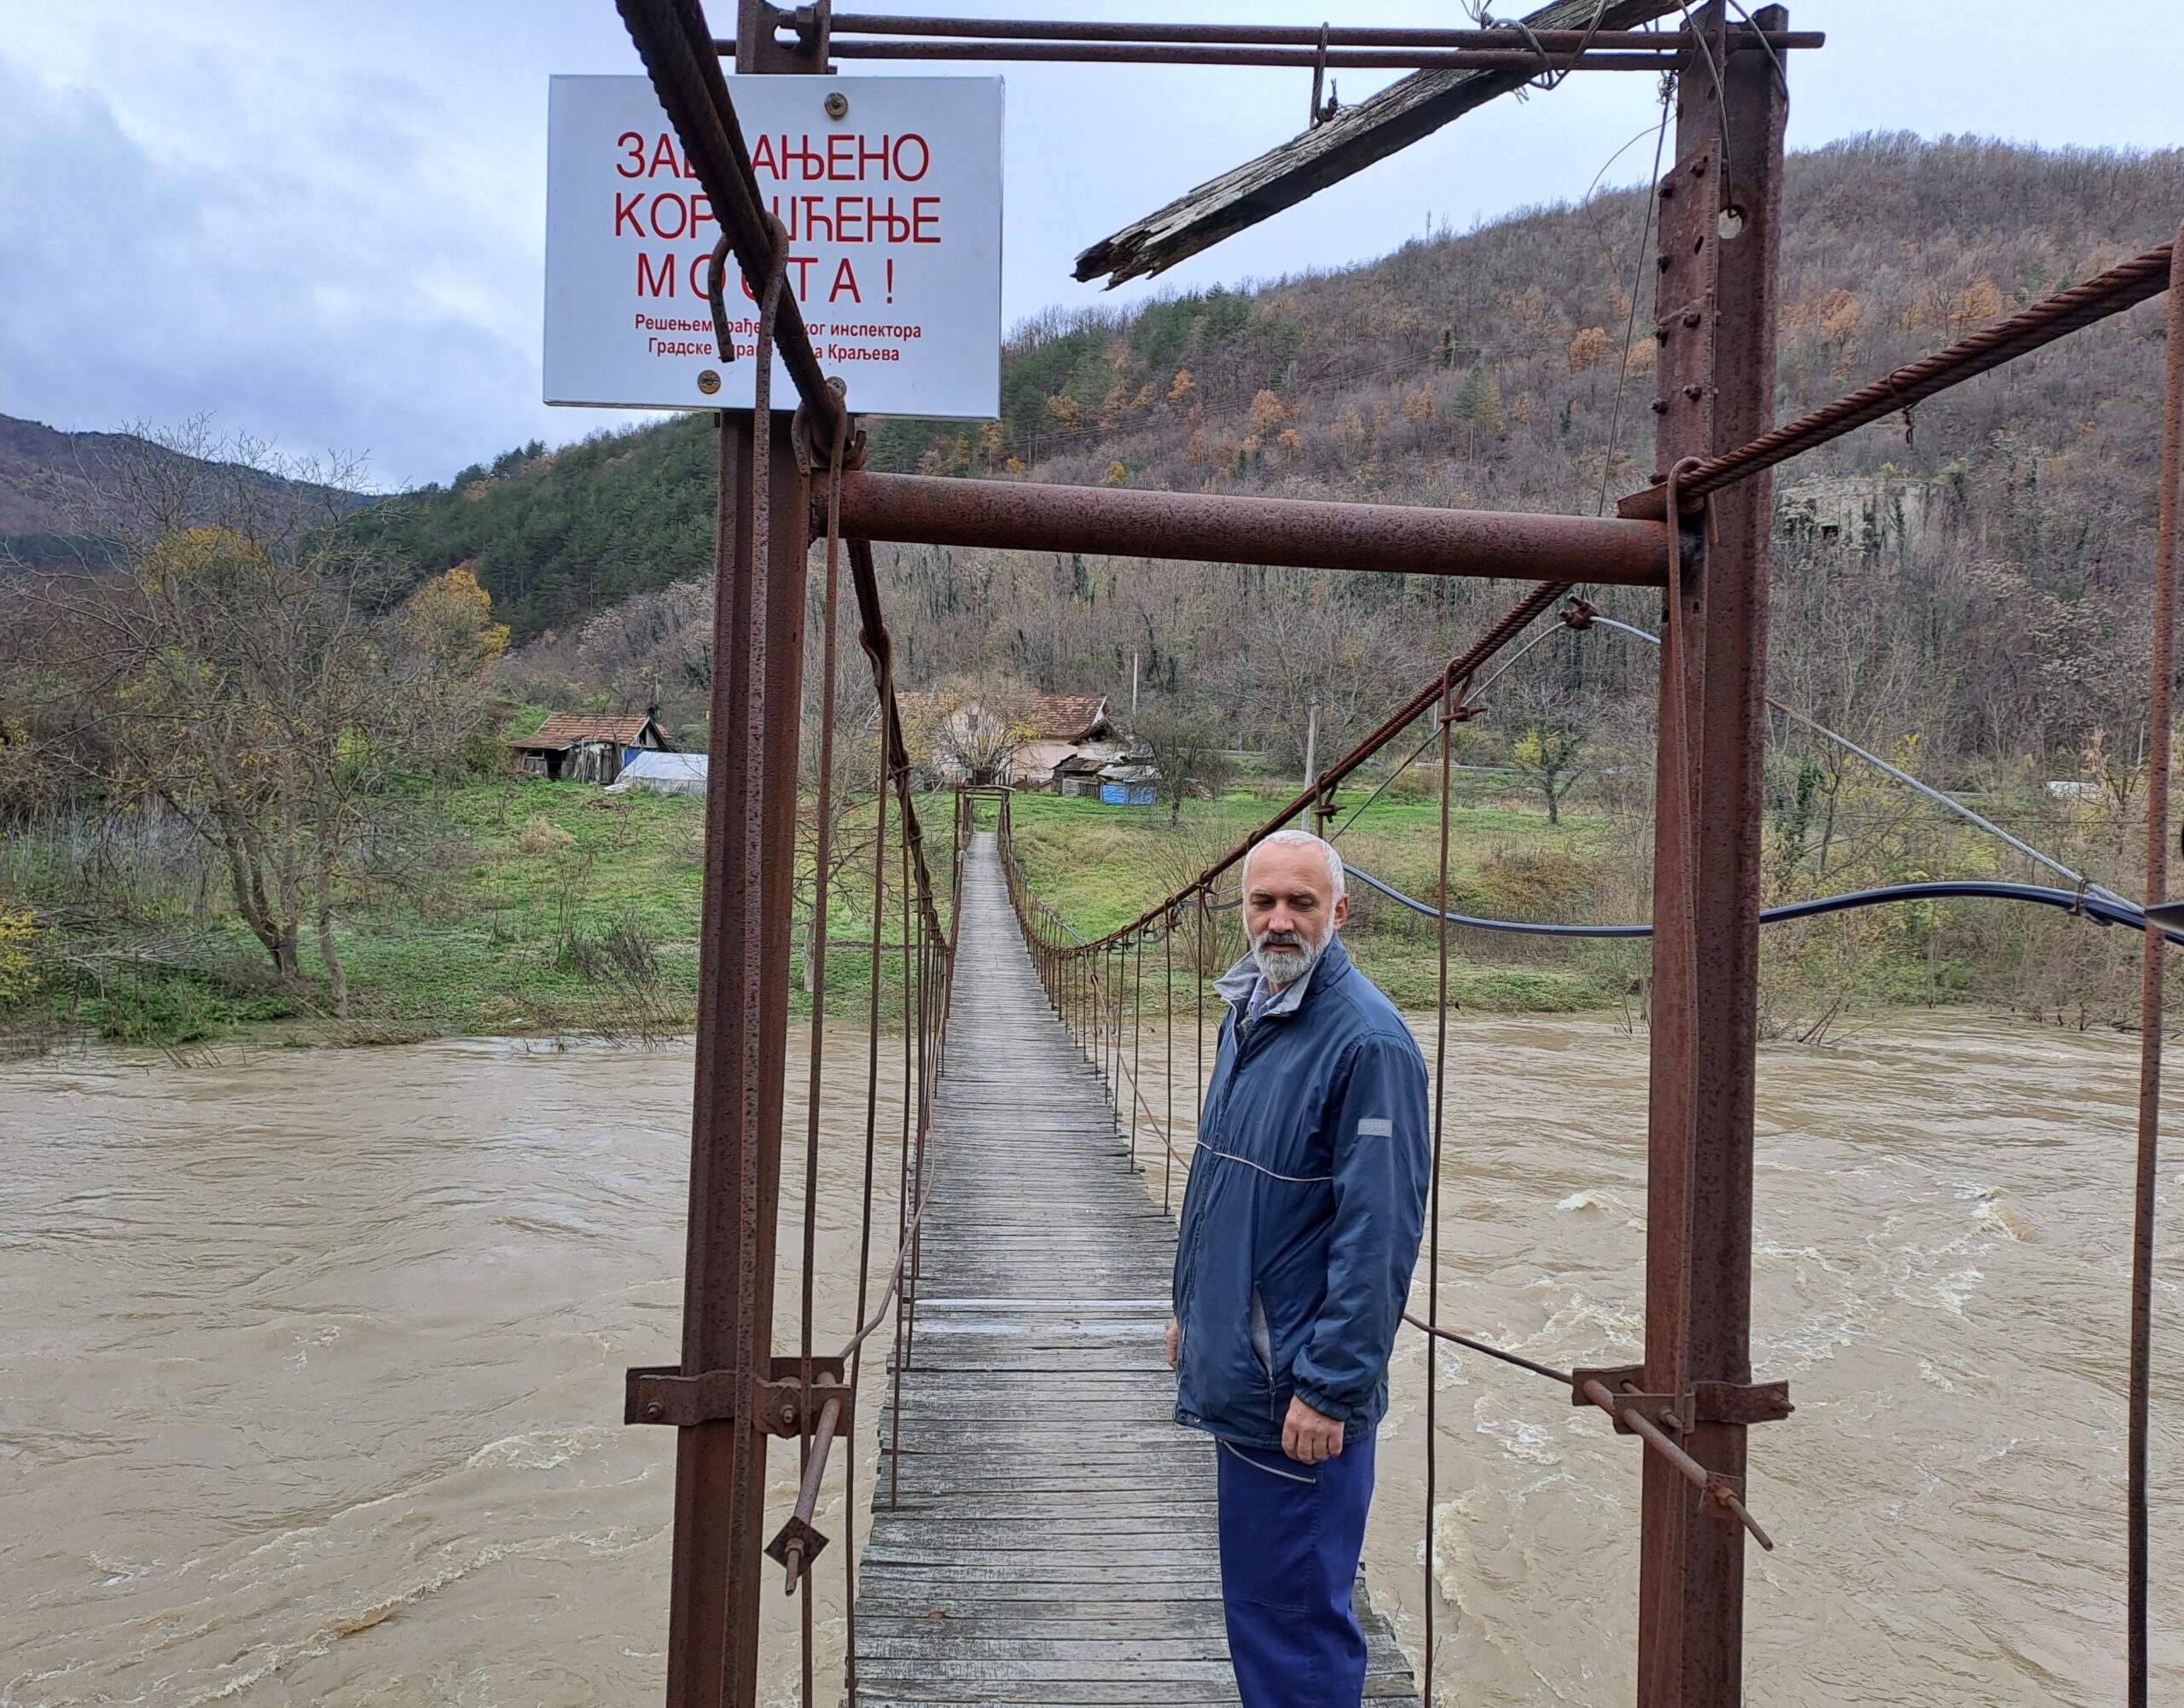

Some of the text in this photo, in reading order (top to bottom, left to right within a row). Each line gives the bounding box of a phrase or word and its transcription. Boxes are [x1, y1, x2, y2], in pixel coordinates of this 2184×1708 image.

[616, 131, 930, 182] ЗААЊЕНО
[635, 313, 712, 333] Решењем
[830, 323, 922, 342] инспектора
[648, 337, 712, 357] Градске
[828, 343, 899, 363] Краљева
